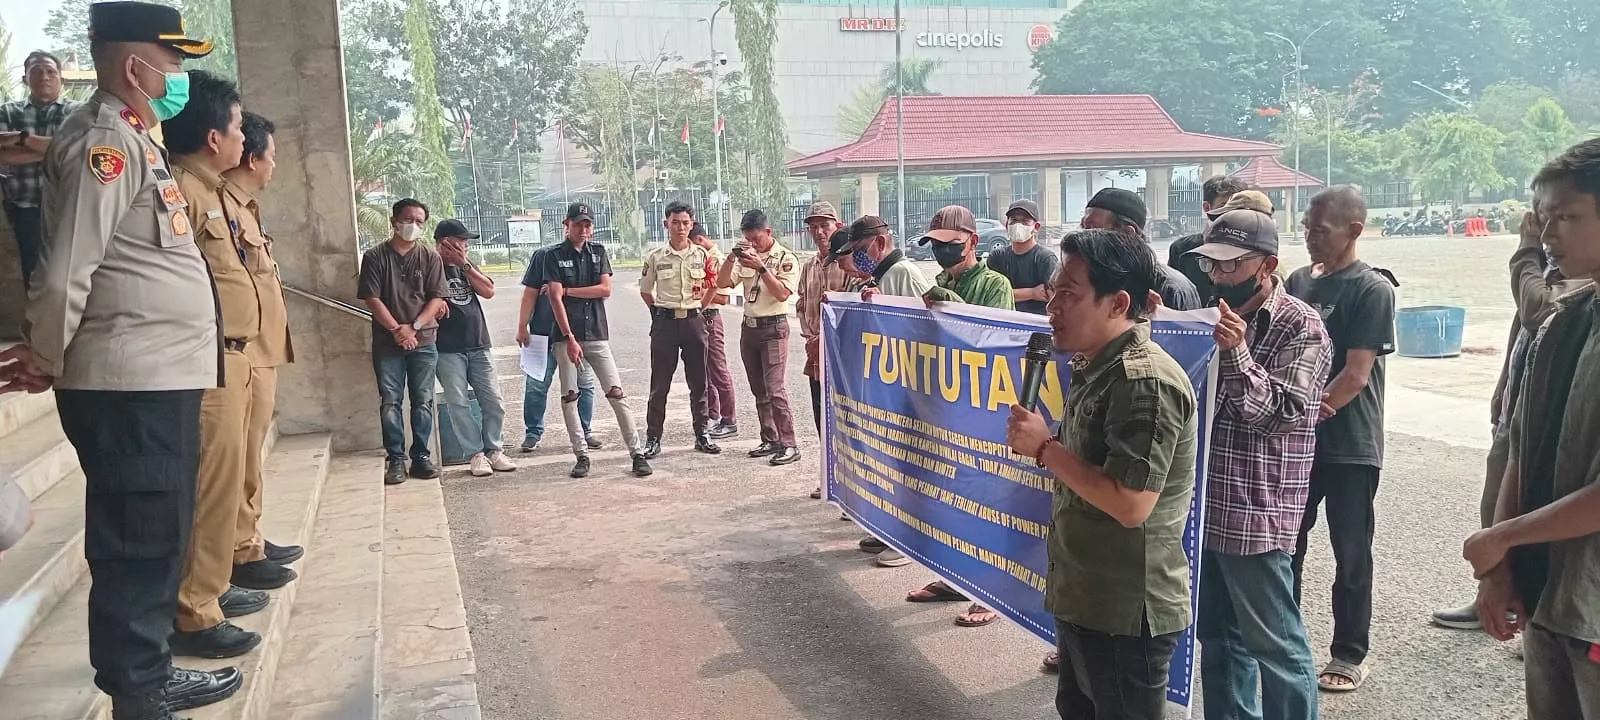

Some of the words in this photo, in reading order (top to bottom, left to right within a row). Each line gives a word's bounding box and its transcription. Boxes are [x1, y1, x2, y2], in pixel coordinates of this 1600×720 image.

[916, 29, 1004, 50] cinepolis
[948, 430, 969, 449] SEGERA
[969, 436, 1006, 459] MENCOPOT
[922, 455, 935, 471] DAN
[978, 457, 998, 475] TIDAK
[1020, 472, 1043, 490] SERTA
[1044, 476, 1055, 493] BE
[939, 487, 954, 505] YANG
[953, 494, 979, 516] TERLIBAT
[978, 504, 1001, 524] ABUSE
[1000, 512, 1012, 528] OF
[1011, 515, 1041, 538] POWER
[952, 535, 978, 560] PEJABAT,
[978, 547, 1006, 572] MANTAN
[1030, 571, 1039, 589] DI
